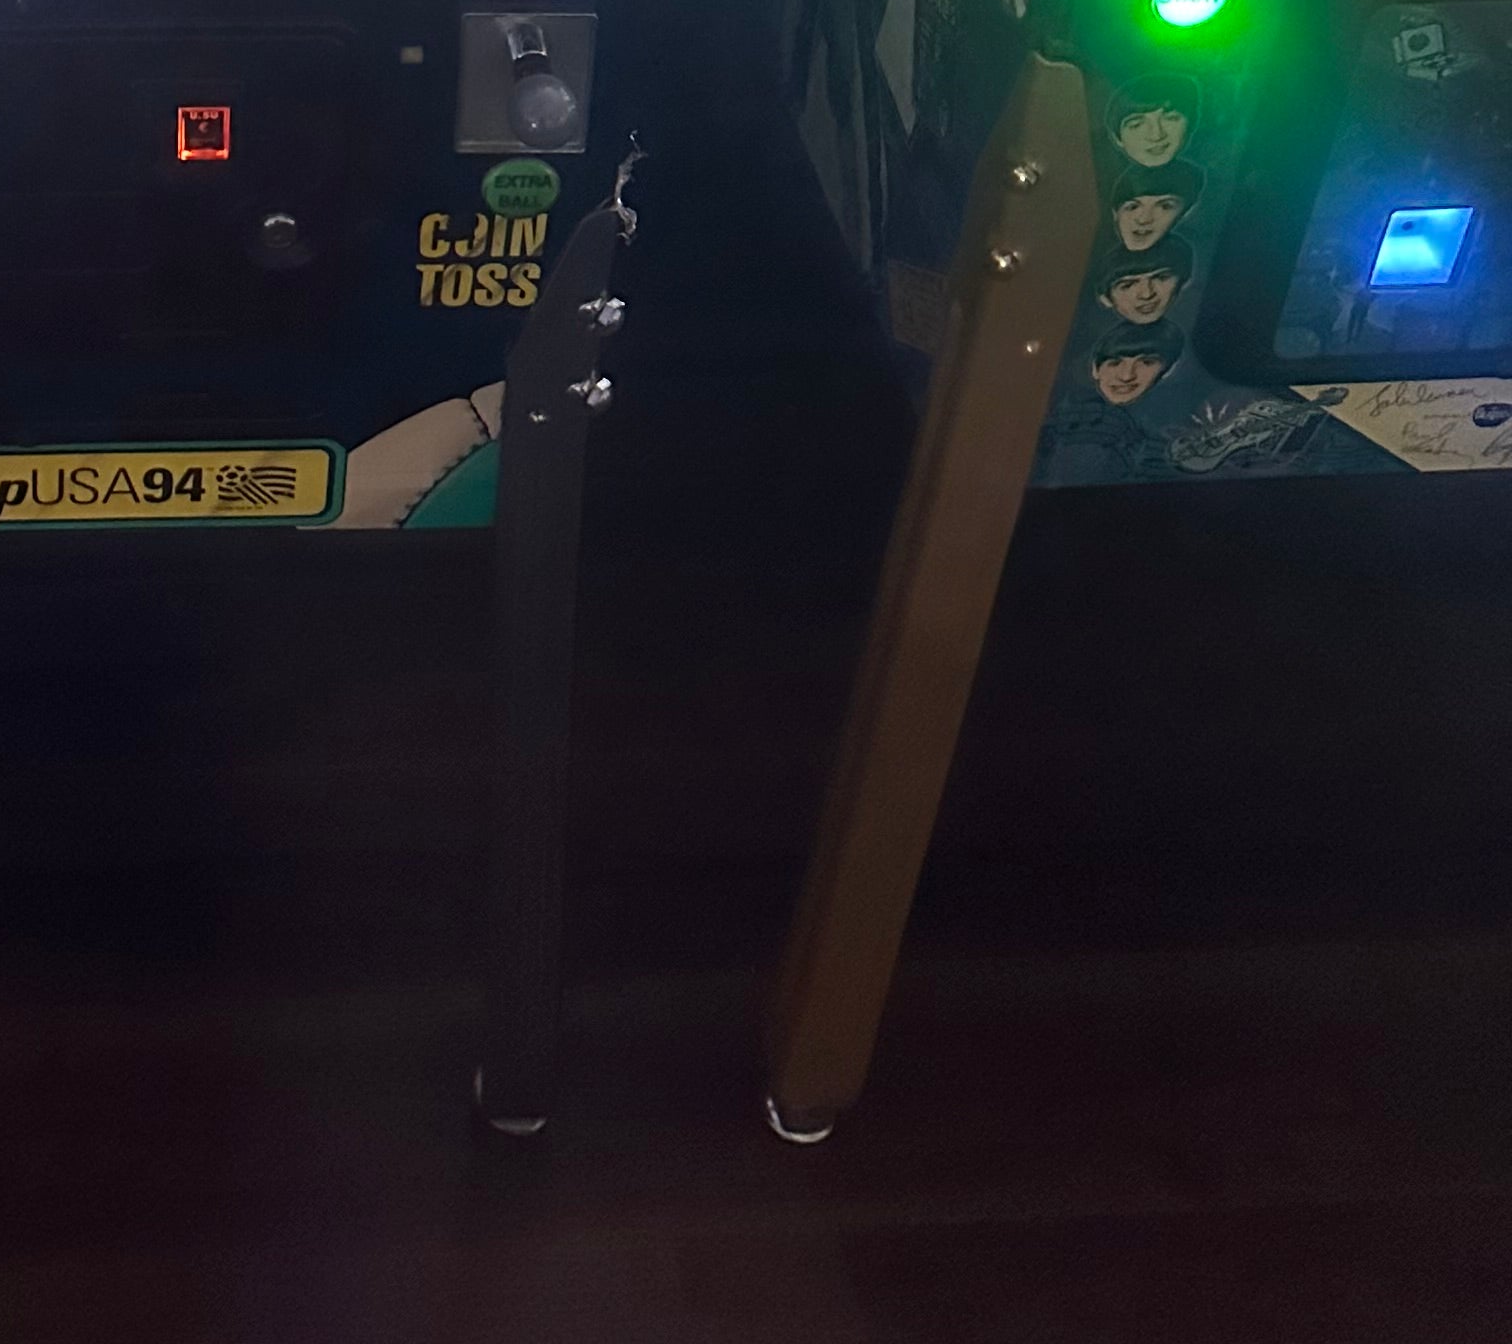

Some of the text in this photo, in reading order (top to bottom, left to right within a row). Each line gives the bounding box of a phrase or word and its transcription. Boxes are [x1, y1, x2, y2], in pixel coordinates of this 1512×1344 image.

[494, 174, 552, 190] EXTRA
[498, 194, 539, 209] BALL
[416, 262, 541, 307] TOSS
